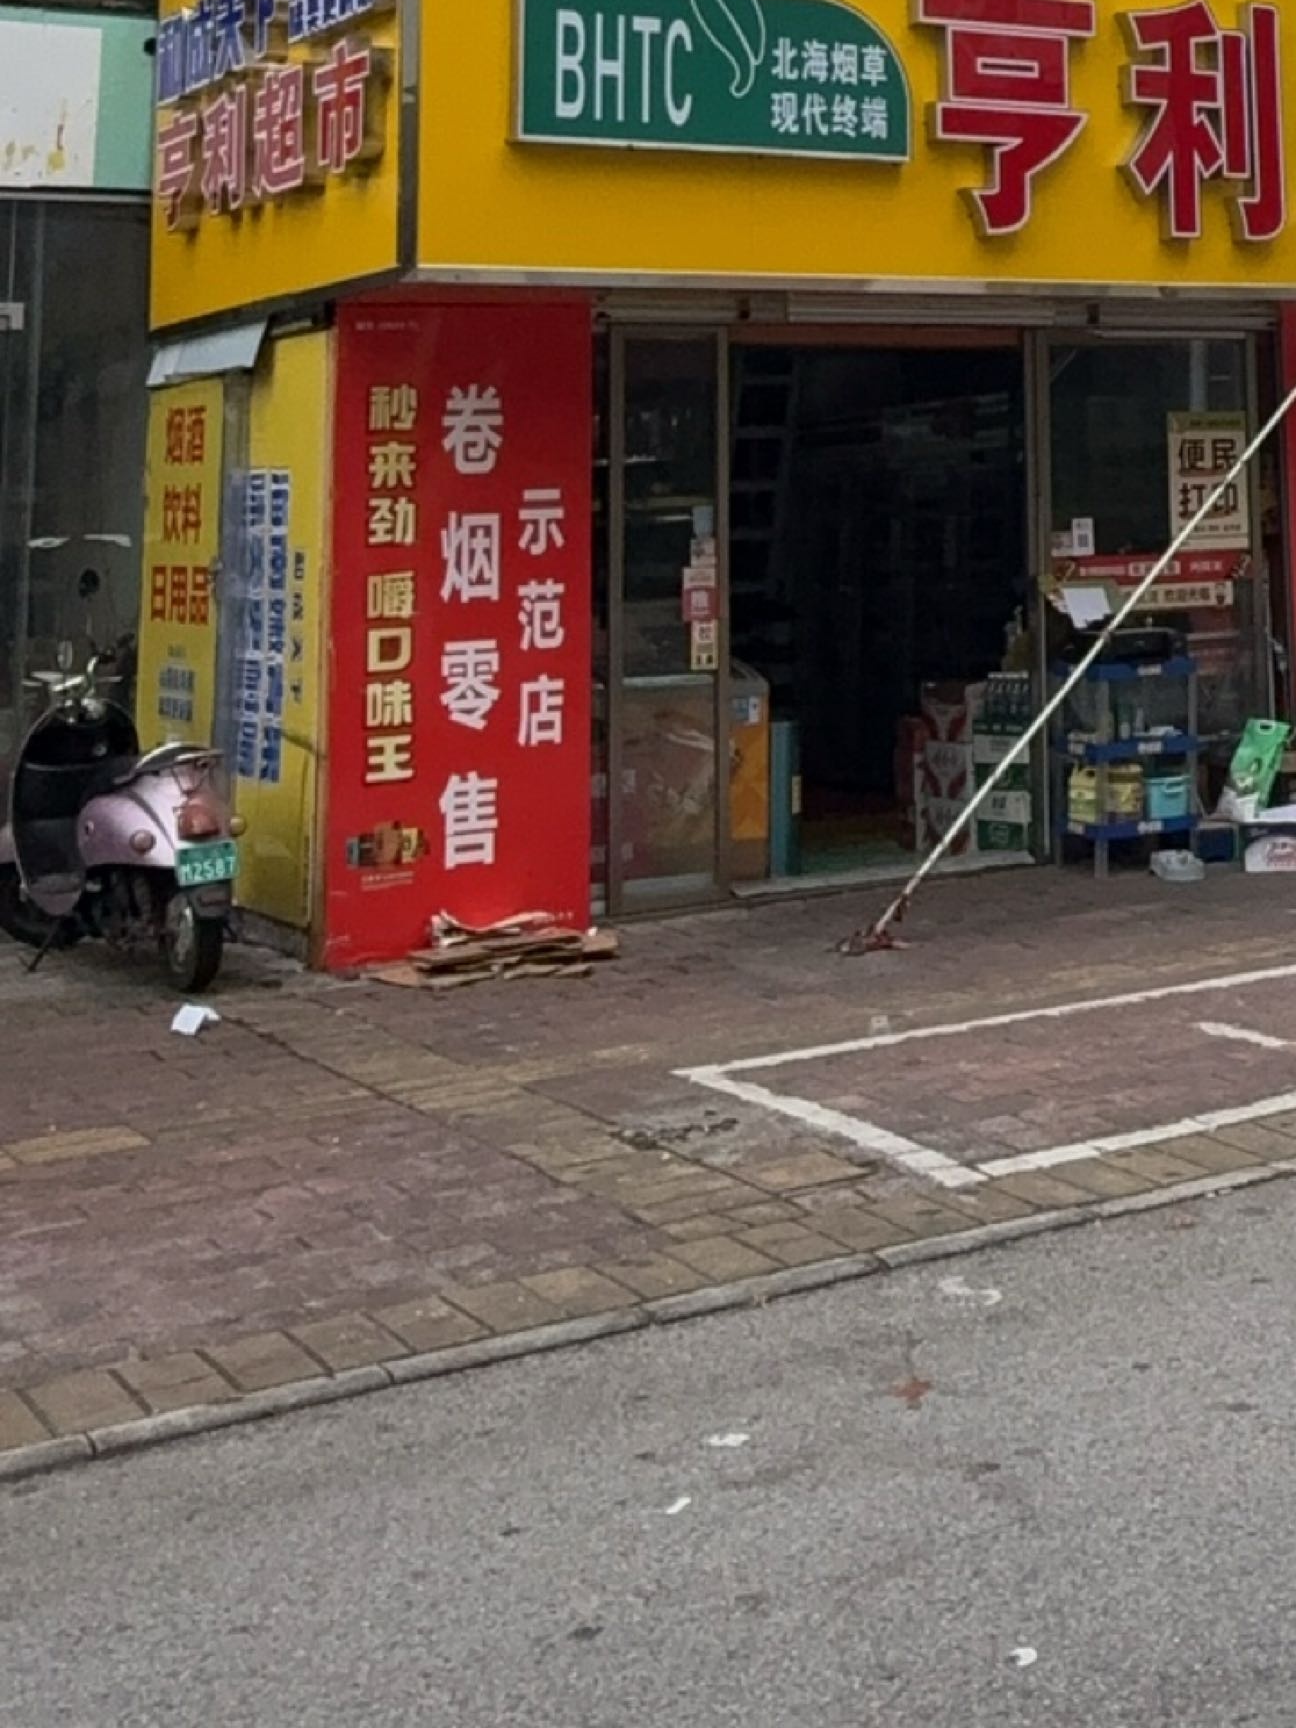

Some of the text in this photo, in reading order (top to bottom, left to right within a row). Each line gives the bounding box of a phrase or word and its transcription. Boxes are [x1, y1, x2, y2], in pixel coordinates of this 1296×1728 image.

[554, 8, 693, 127] BHTC
[770, 37, 889, 87] 北海烟草
[157, 39, 370, 231] 亨利超市
[770, 92, 889, 140] 现代终端
[367, 383, 418, 547] 秒来劲
[1178, 437, 1238, 471] 便民
[1178, 481, 1238, 517] 打印
[163, 483, 202, 545] 饮料
[150, 565, 210, 625] 日用品
[440, 383, 504, 871] 卷烟零售
[517, 488, 566, 748] 示范店
[365, 570, 416, 785] 嚼口味王
